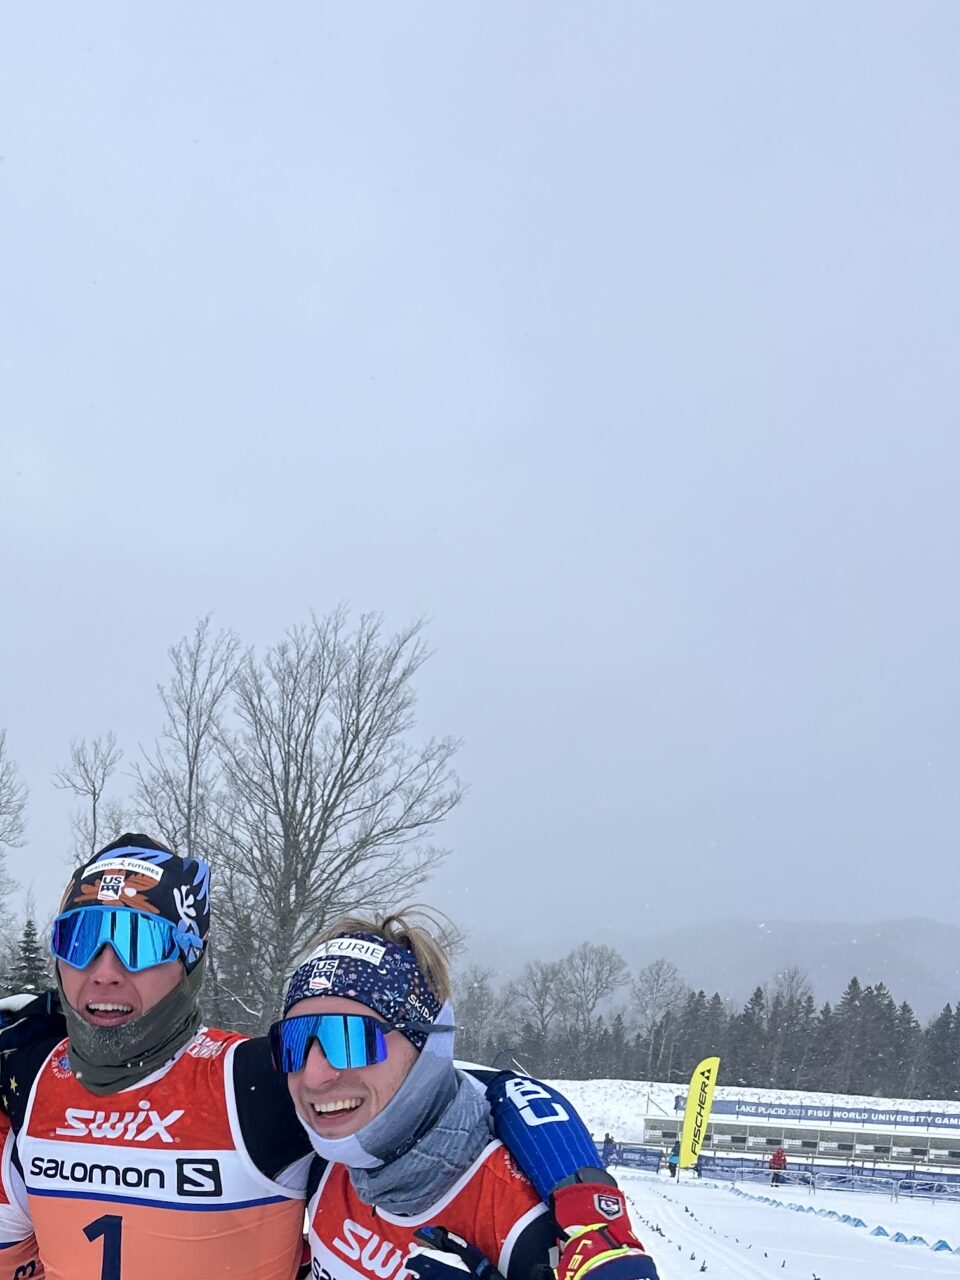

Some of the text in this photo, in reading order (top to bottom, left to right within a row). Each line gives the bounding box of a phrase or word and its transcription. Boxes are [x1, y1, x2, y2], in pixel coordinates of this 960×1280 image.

[127, 862, 159, 876] FUTURES
[103, 876, 123, 885] US
[315, 961, 337, 971] US
[407, 994, 434, 1024] SKIDA
[691, 1081, 710, 1156] FISCHER
[736, 1104, 757, 1113] LAKE
[758, 1106, 786, 1116] PLACID
[807, 1109, 831, 1119] FISU
[833, 1111, 869, 1120] WORLD
[871, 1113, 933, 1123] UNIVERSITY
